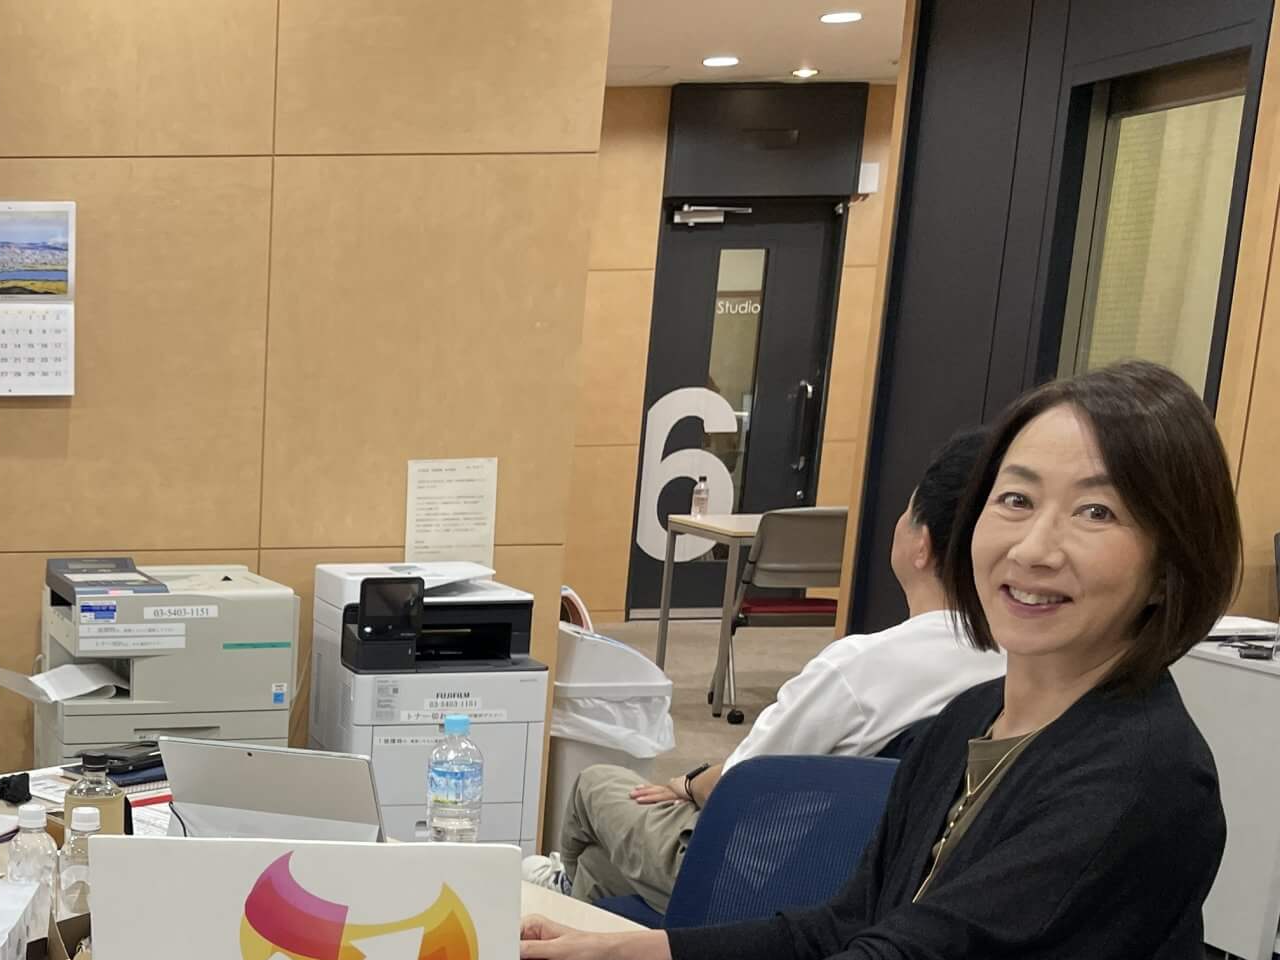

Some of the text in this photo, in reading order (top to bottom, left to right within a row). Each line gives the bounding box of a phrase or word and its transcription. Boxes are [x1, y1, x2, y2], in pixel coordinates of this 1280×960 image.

[716, 300, 761, 315] Studio
[636, 386, 738, 563] 6
[152, 607, 210, 618] 03-5403-1151
[435, 691, 471, 700] FUJIFILM
